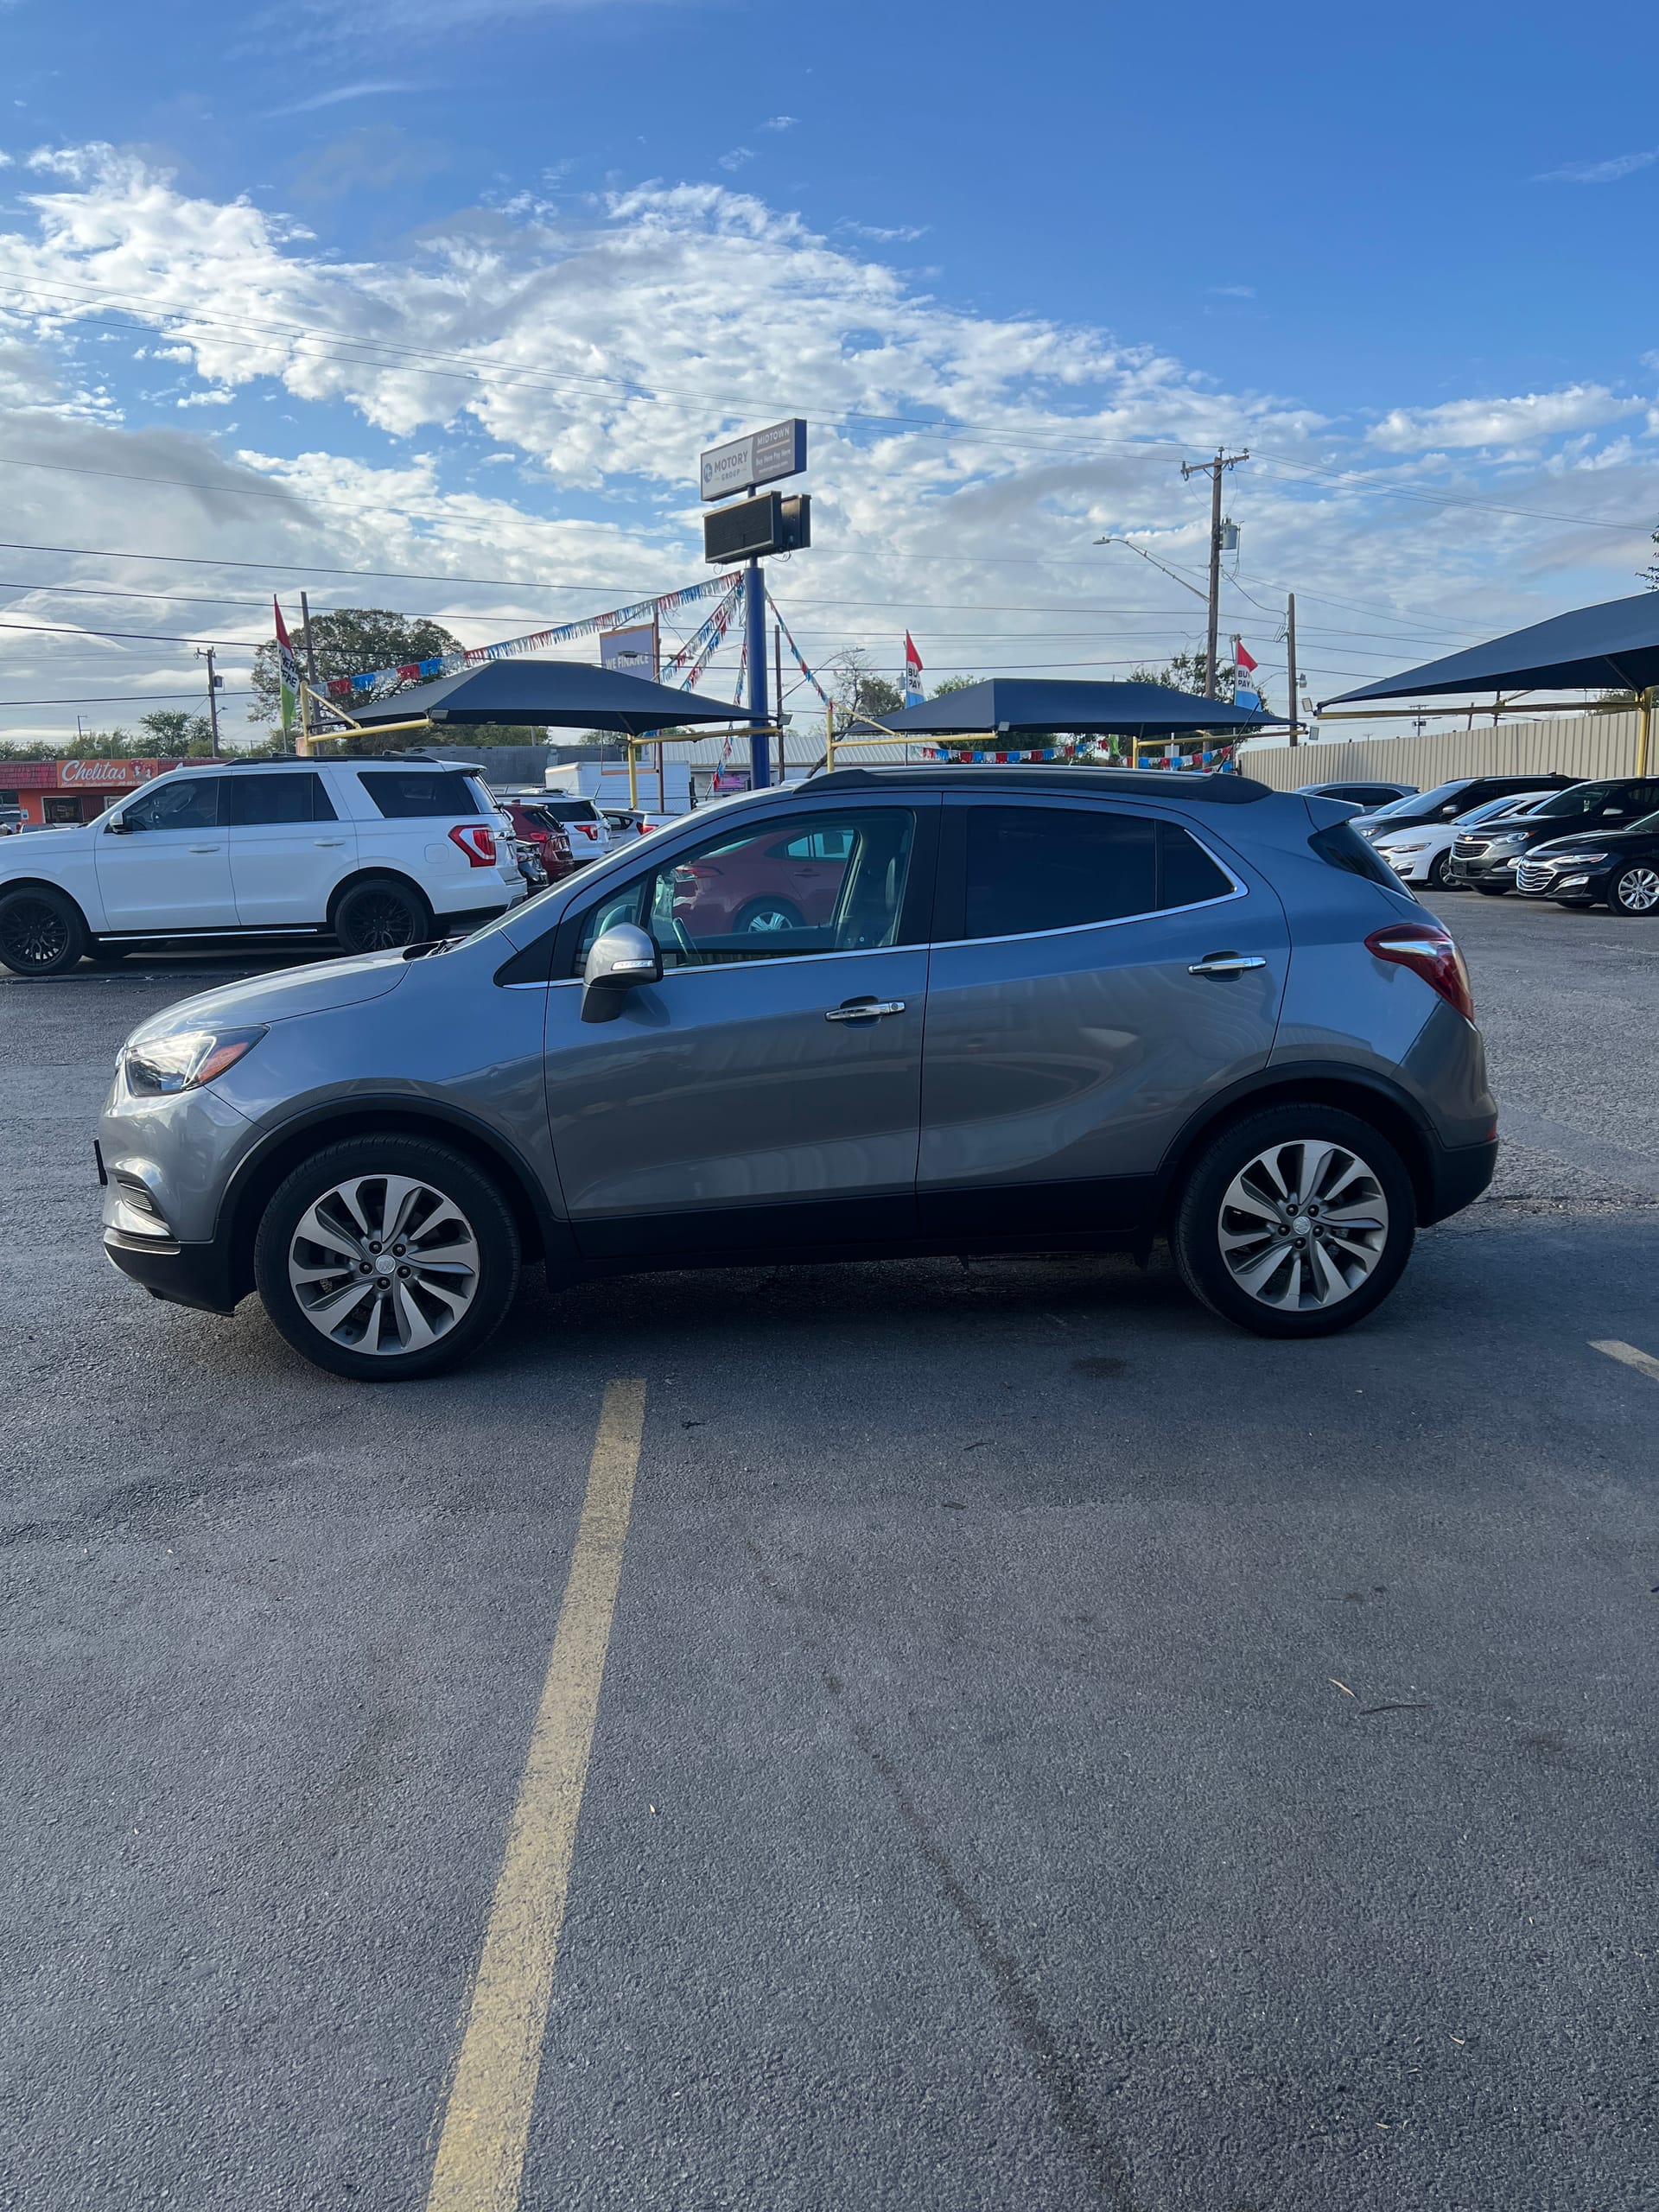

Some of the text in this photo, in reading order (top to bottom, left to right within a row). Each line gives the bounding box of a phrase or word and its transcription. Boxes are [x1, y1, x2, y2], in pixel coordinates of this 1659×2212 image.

[757, 427, 790, 445] MIDTOWN
[714, 450, 748, 473] MOTORY
[721, 468, 741, 480] GROUP
[908, 679, 921, 690] PAY
[1238, 679, 1251, 689] PAY
[61, 760, 126, 782] Chelitas
